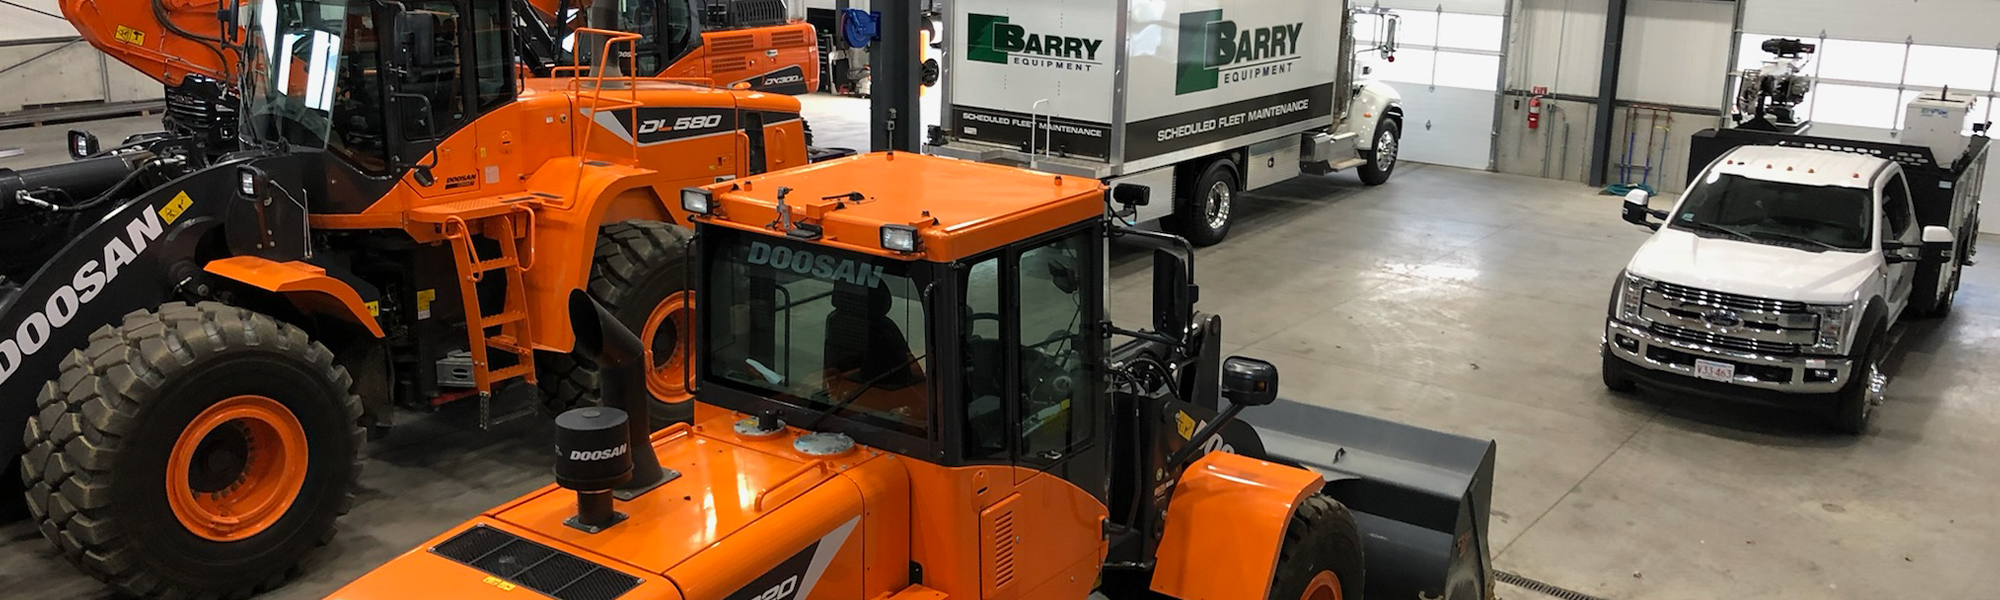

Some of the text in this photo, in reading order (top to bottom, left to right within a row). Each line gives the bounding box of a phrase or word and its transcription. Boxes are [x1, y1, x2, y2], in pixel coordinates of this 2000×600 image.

[993, 22, 1102, 60] BARRY
[1204, 20, 1303, 69] BARRY
[1014, 57, 1092, 71] EQUIPMENT
[1224, 62, 1292, 84] EQUIPMENT
[638, 114, 722, 134] DL580
[962, 112, 1010, 125] SCHEDULED
[1039, 122, 1103, 137] MAINTENANCE
[1157, 99, 1309, 142] SCHEDULED FLEET MAINTENANCE
[747, 241, 884, 289] DOOSAN
[0, 204, 164, 386] DOOSAN
[570, 443, 627, 461] DOOSAN
